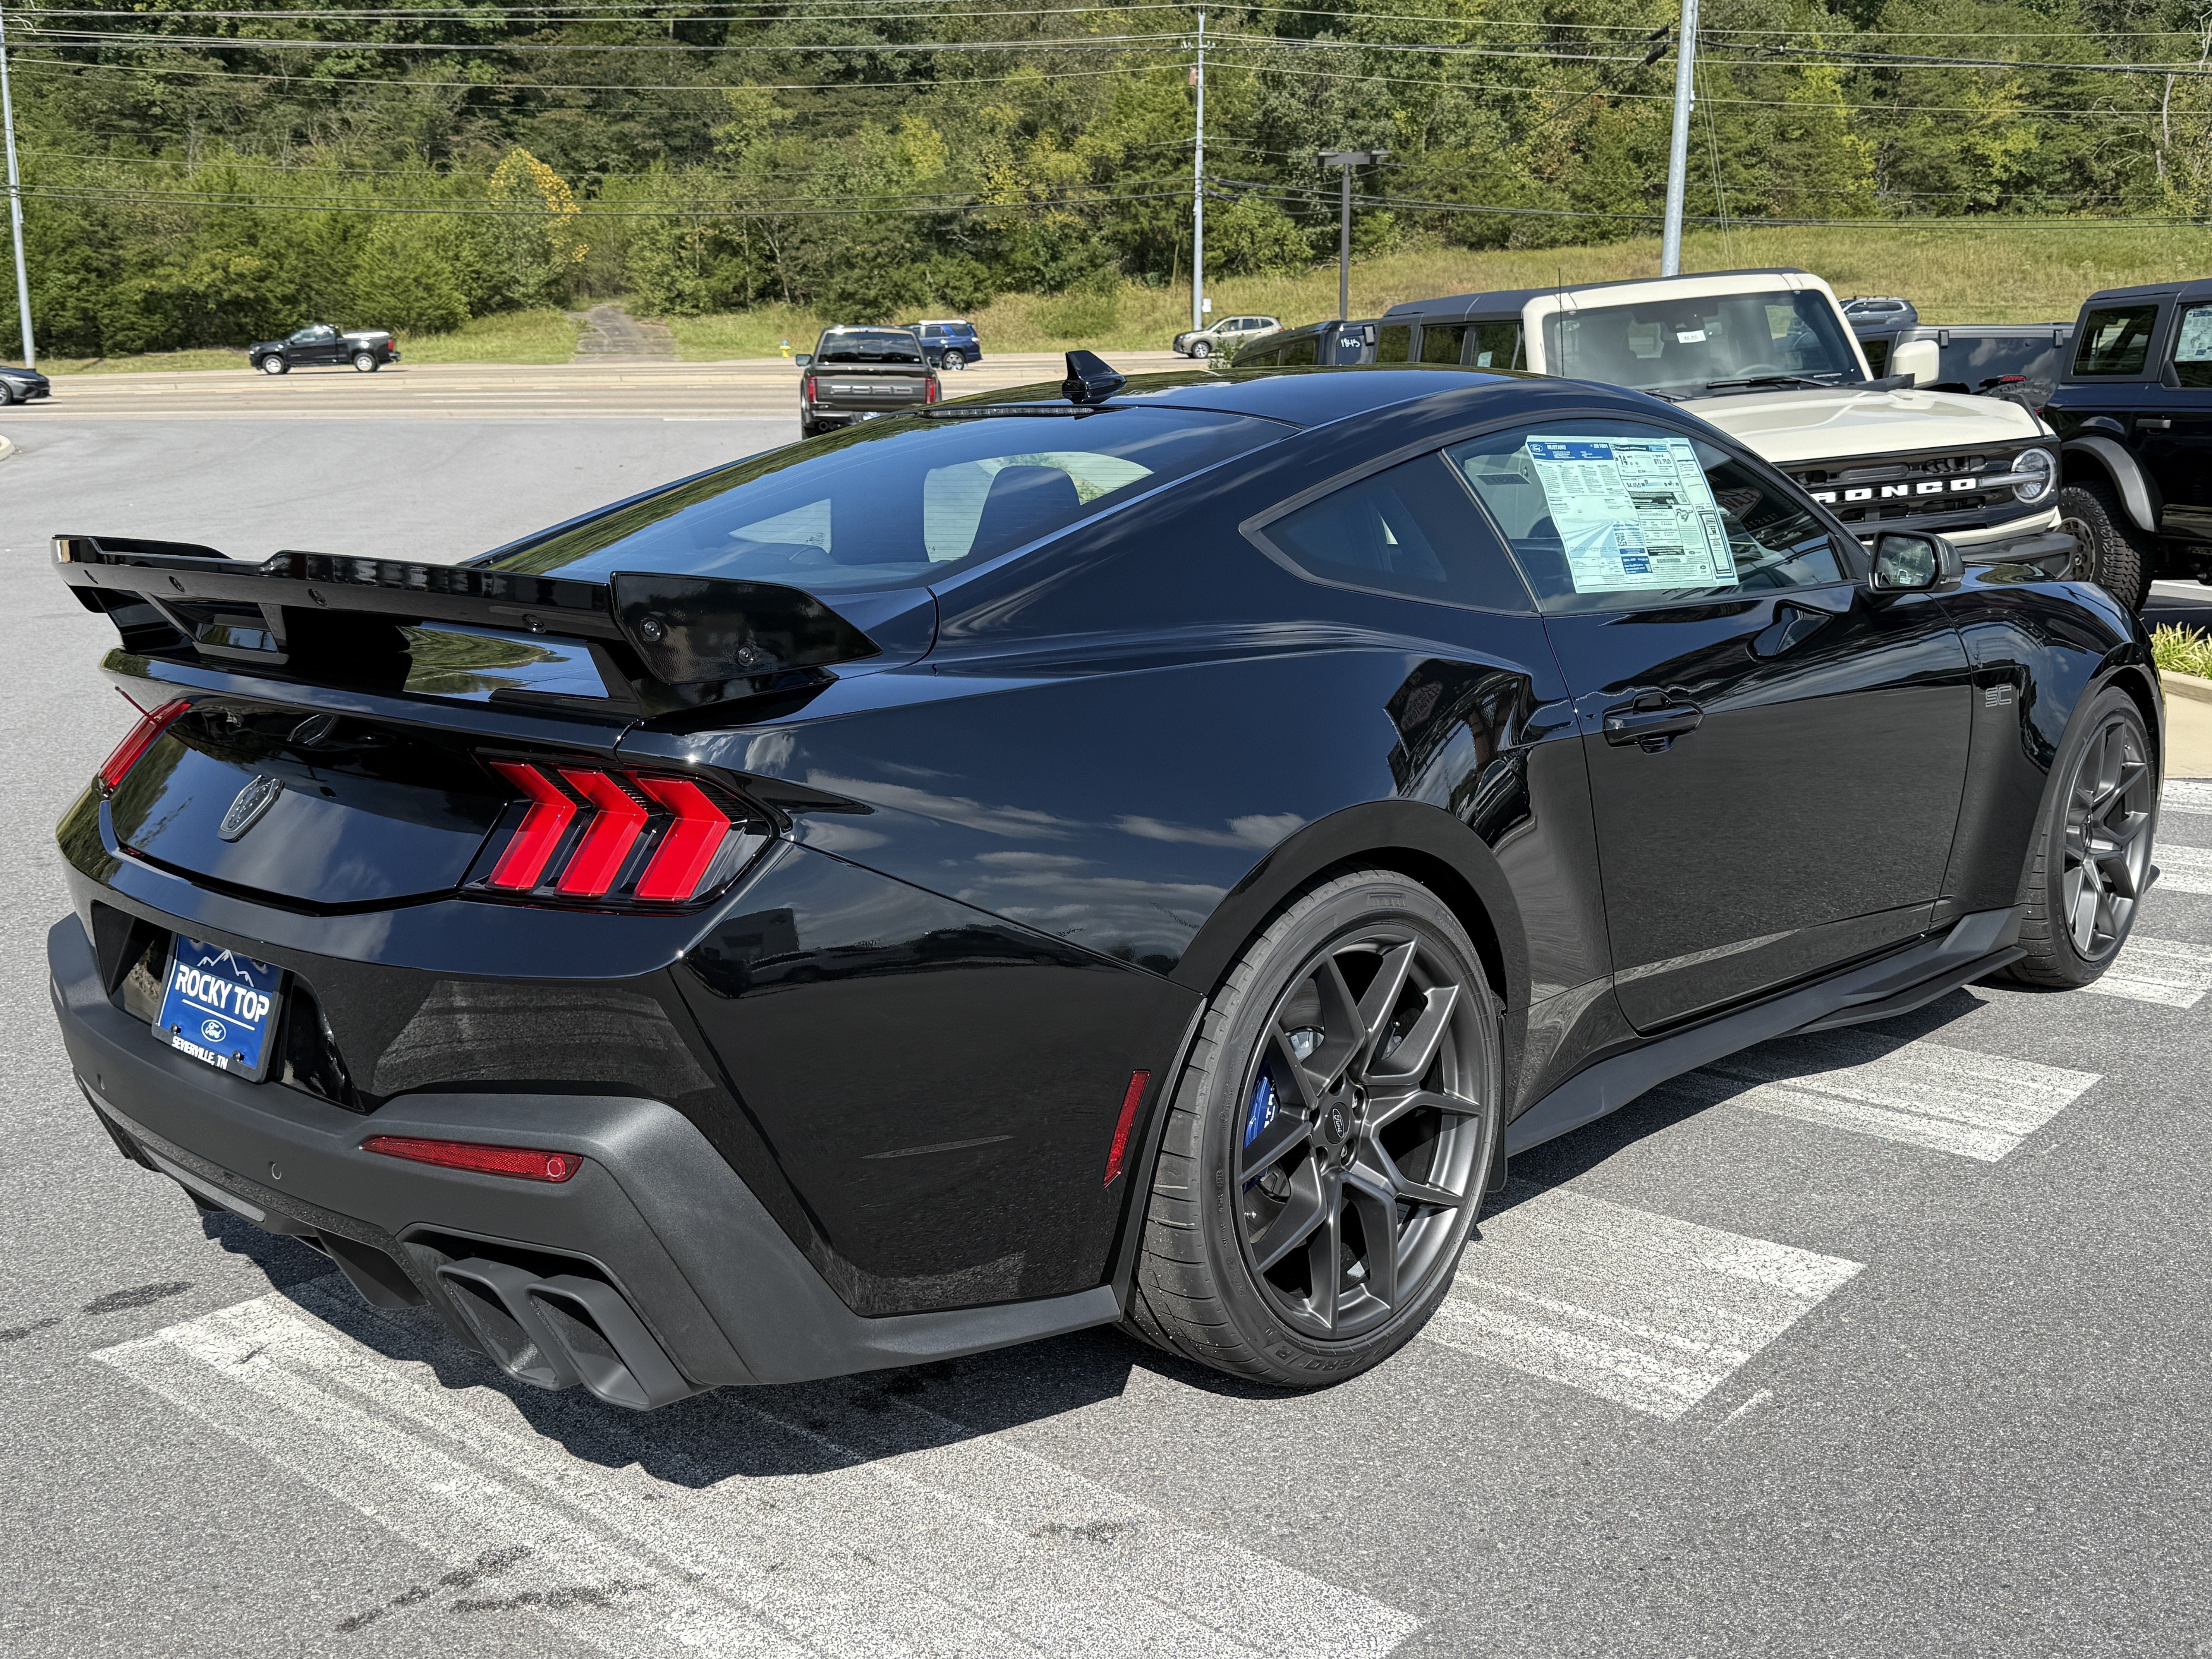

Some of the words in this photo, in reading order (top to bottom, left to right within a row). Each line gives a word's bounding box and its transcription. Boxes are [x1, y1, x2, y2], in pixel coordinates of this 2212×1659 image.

[1341, 338, 1360, 347] 1845
[830, 385, 914, 394] FORD
[1810, 478, 1976, 503] RONCO
[1985, 685, 2012, 708] SC
[175, 965, 232, 1009] ROCKY
[234, 986, 270, 1022] TOP
[204, 1021, 223, 1040] Ford
[217, 1055, 229, 1070] TN
[1333, 1112, 1343, 1135] Ford
[1304, 1352, 1370, 1371] ZERO
